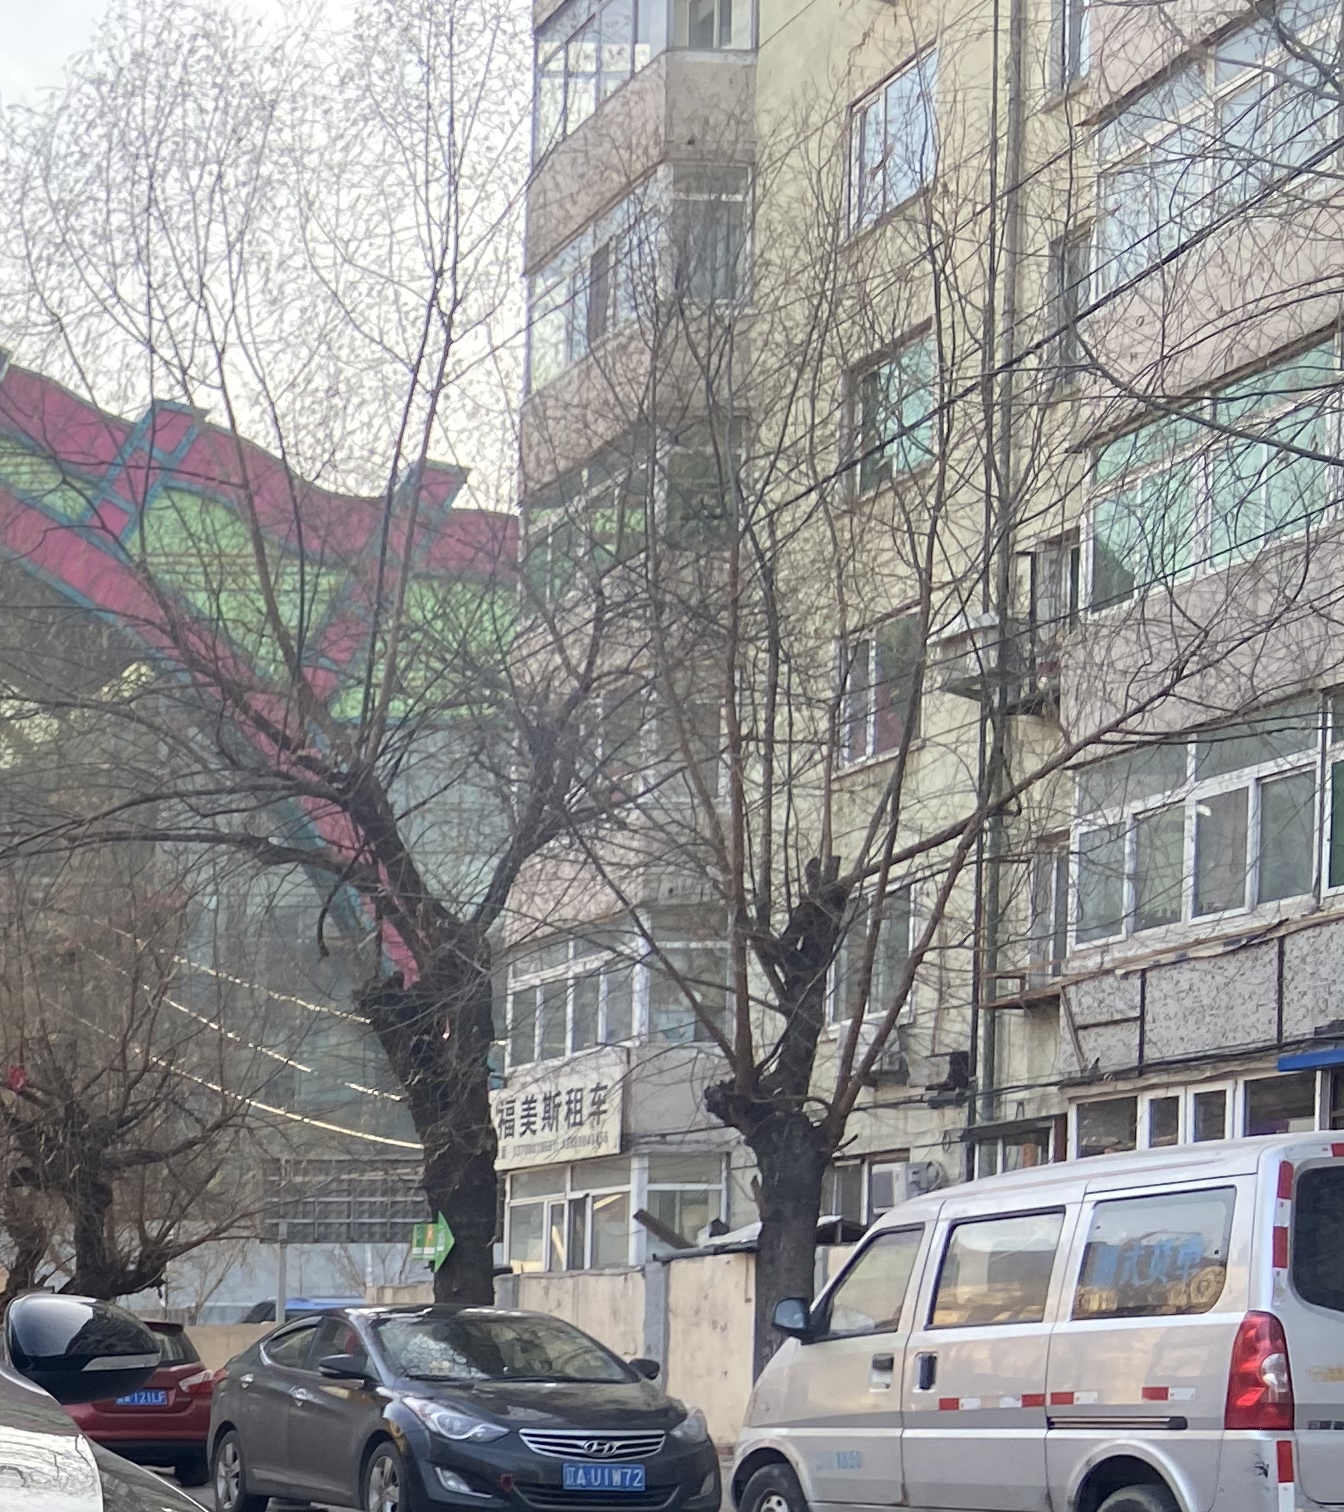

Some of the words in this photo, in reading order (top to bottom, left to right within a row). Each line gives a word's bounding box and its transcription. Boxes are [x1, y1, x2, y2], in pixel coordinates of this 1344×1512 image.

[498, 1082, 609, 1140] 福美斯租车
